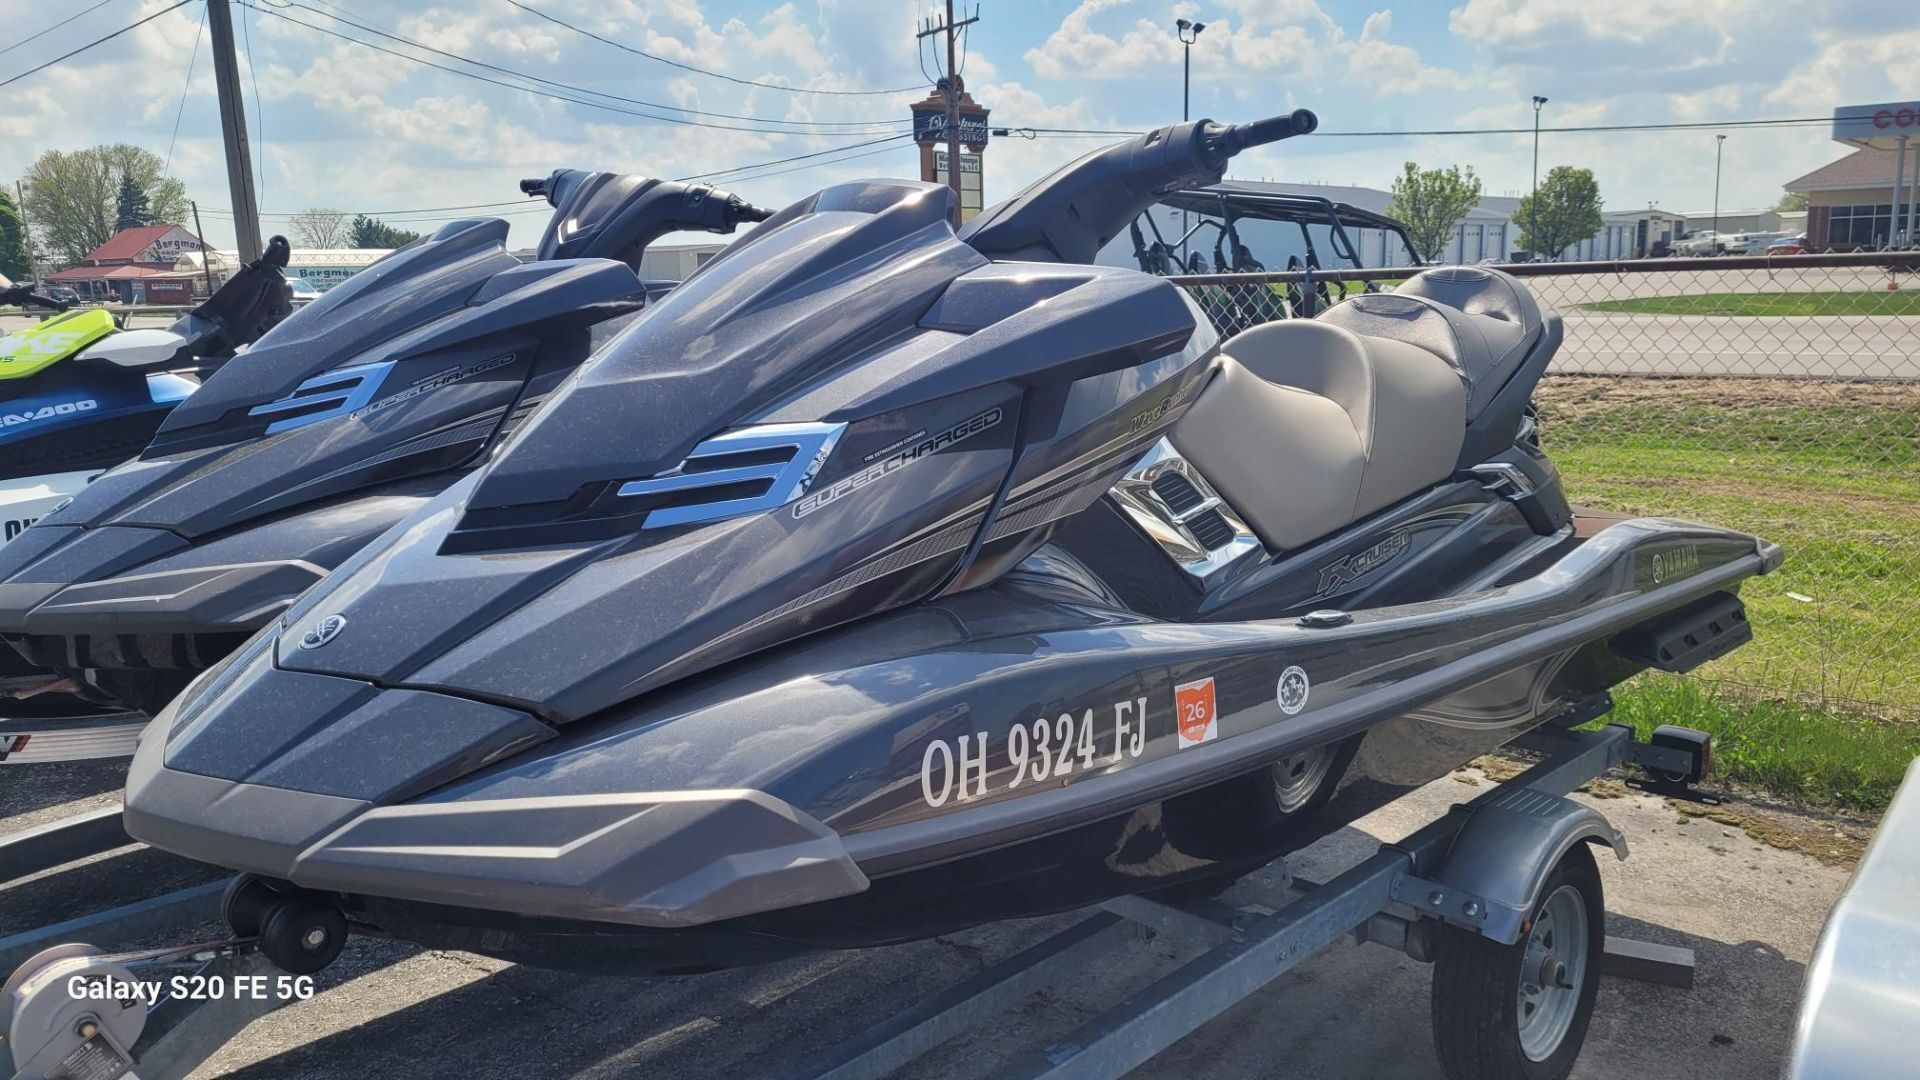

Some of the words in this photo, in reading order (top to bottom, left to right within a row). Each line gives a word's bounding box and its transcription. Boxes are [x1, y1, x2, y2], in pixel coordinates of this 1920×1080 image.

[1873, 109, 1920, 129] CO
[155, 239, 202, 252] Bergman
[792, 408, 1002, 519] SUPERCHARGED
[5, 517, 39, 542] O
[1662, 544, 1699, 579] YAMAHA
[1186, 700, 1205, 722] 26
[921, 731, 988, 808] OH
[1008, 709, 1096, 789] 9324
[1112, 697, 1147, 762] FJ
